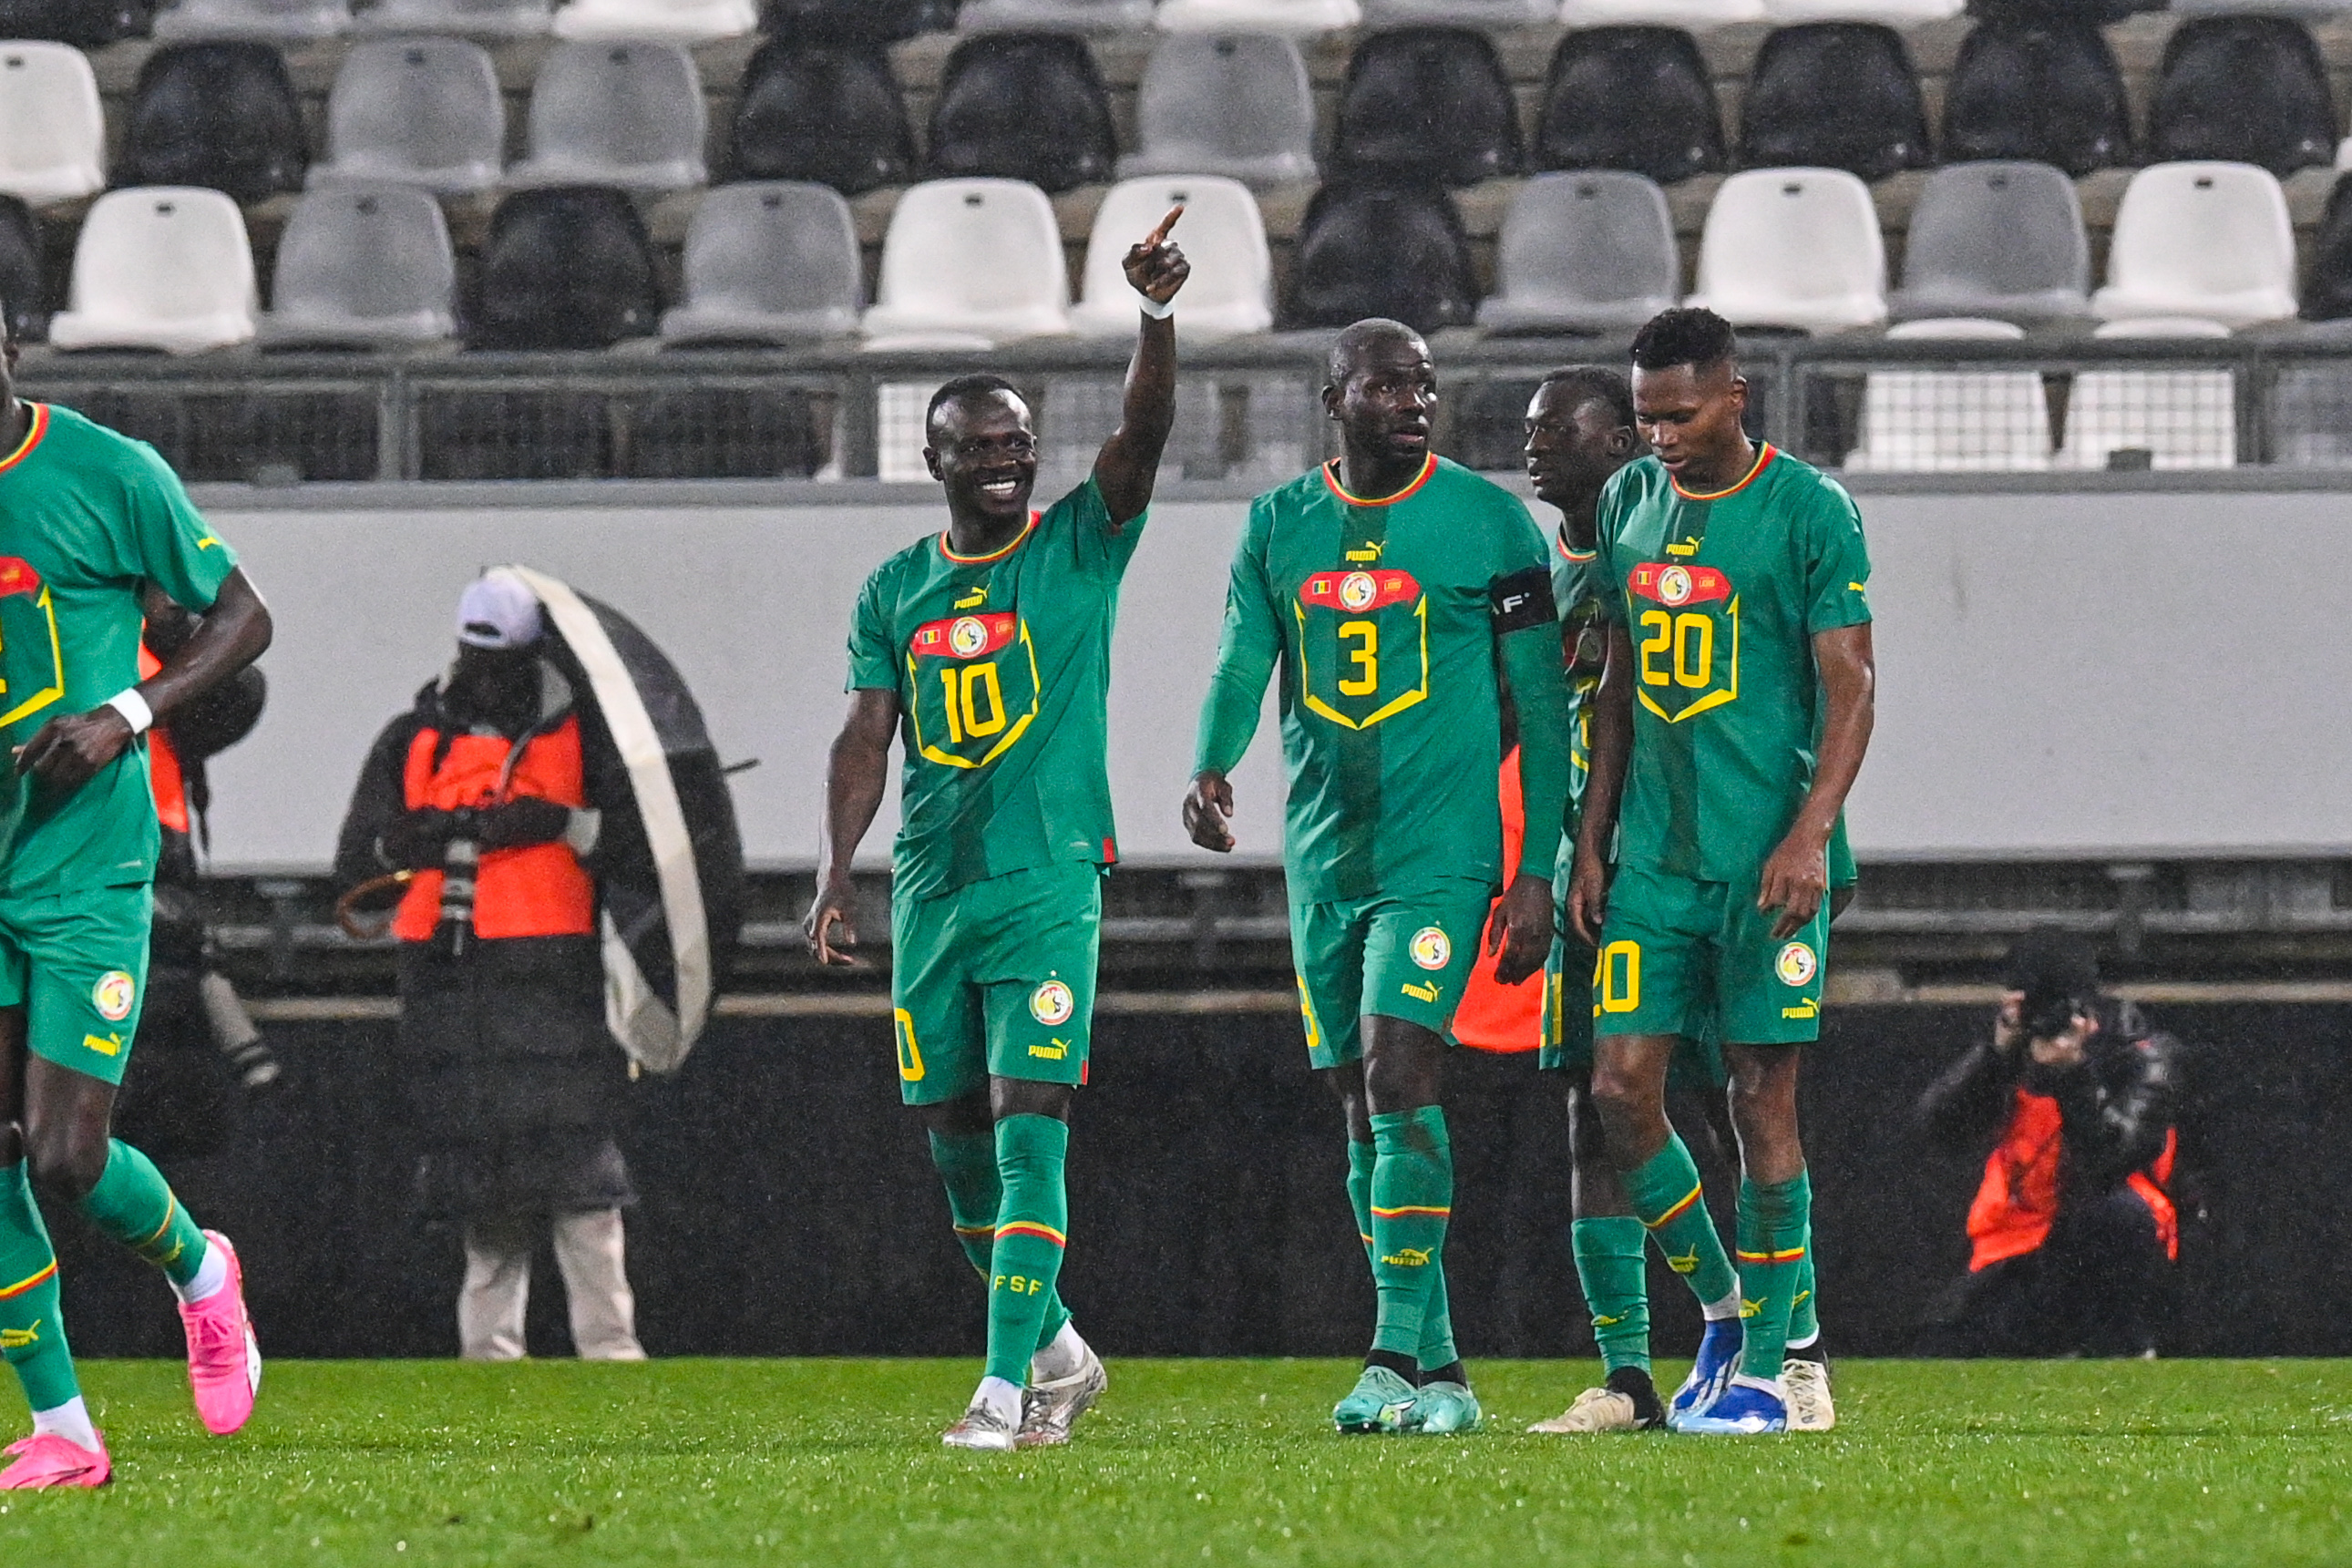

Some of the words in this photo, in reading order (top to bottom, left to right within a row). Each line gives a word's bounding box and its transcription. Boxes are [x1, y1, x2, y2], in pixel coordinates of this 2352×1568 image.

[1339, 620, 1379, 697] 3
[1640, 610, 1714, 690] 20
[940, 661, 1008, 744] 10
[1028, 1045, 1063, 1060] PUMA
[993, 1275, 1042, 1296] FSF
